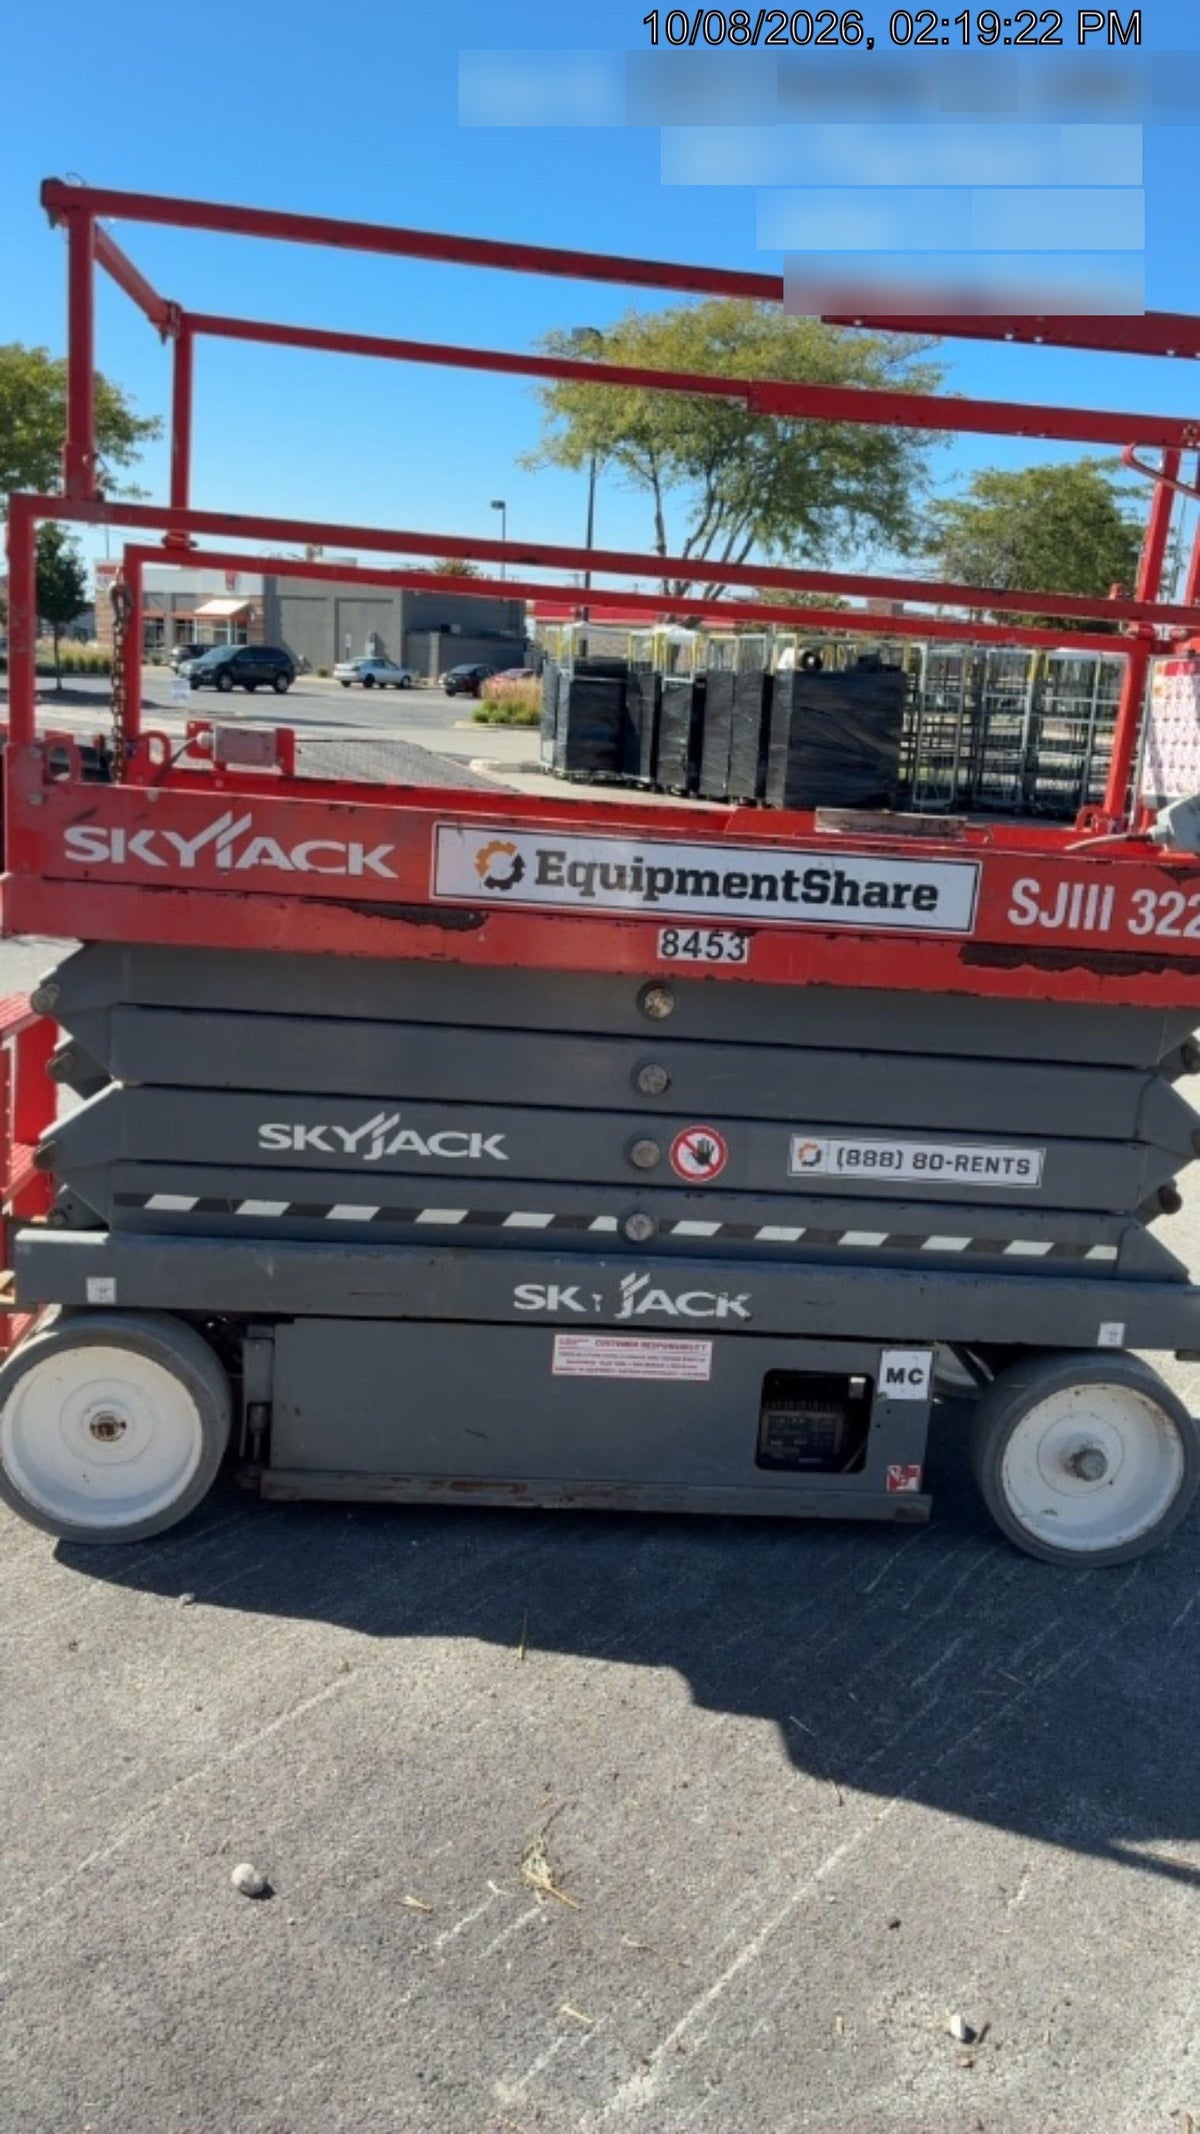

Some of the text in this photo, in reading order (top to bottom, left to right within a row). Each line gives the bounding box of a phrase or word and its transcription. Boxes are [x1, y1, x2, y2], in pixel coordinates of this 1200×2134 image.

[534, 848, 939, 911] EquipmentShare
[1007, 877, 1115, 931] SJIII
[661, 929, 745, 961] 8453
[258, 1111, 510, 1160] SKYJACK
[836, 1147, 1031, 1176] (888) 80-RENTS
[886, 1367, 924, 1385] MC
